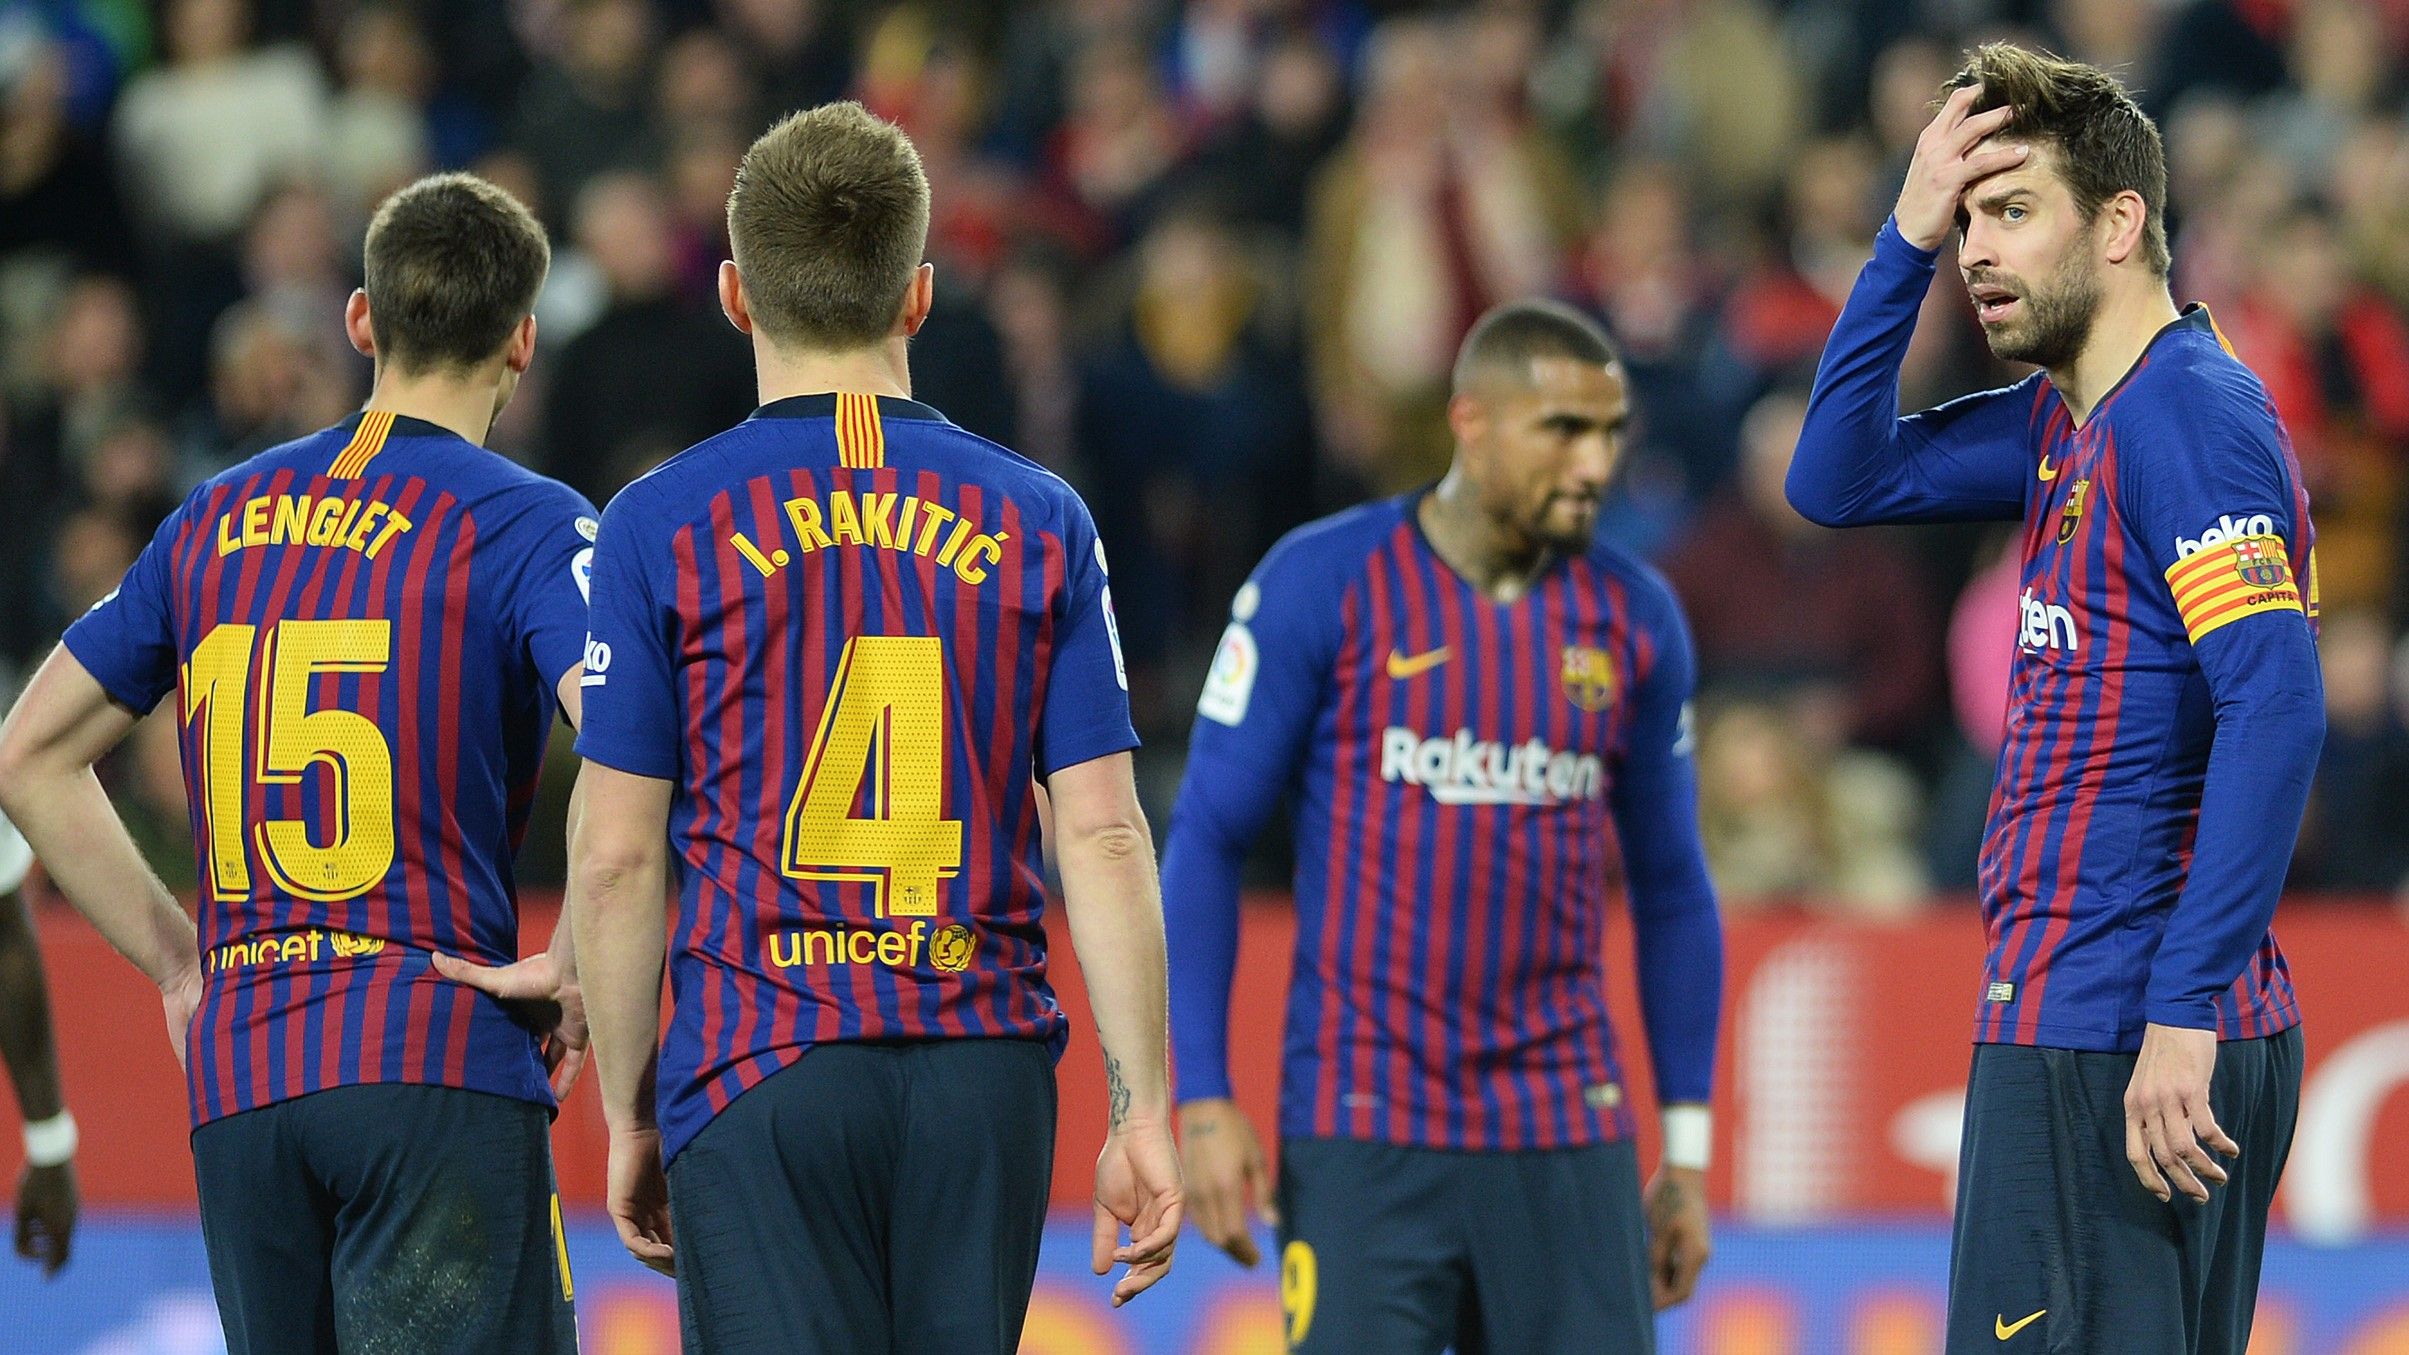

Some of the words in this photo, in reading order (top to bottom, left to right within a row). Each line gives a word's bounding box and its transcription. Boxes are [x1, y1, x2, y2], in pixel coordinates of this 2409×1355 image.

[218, 494, 413, 560] LENGLET
[729, 532, 790, 578] I.
[783, 490, 1010, 586] RAKITIĆ
[2175, 514, 2274, 560] beko
[181, 619, 396, 903] 15
[781, 636, 963, 919] 4
[1380, 726, 1603, 802] Rakuten
[769, 920, 926, 969] unicef
